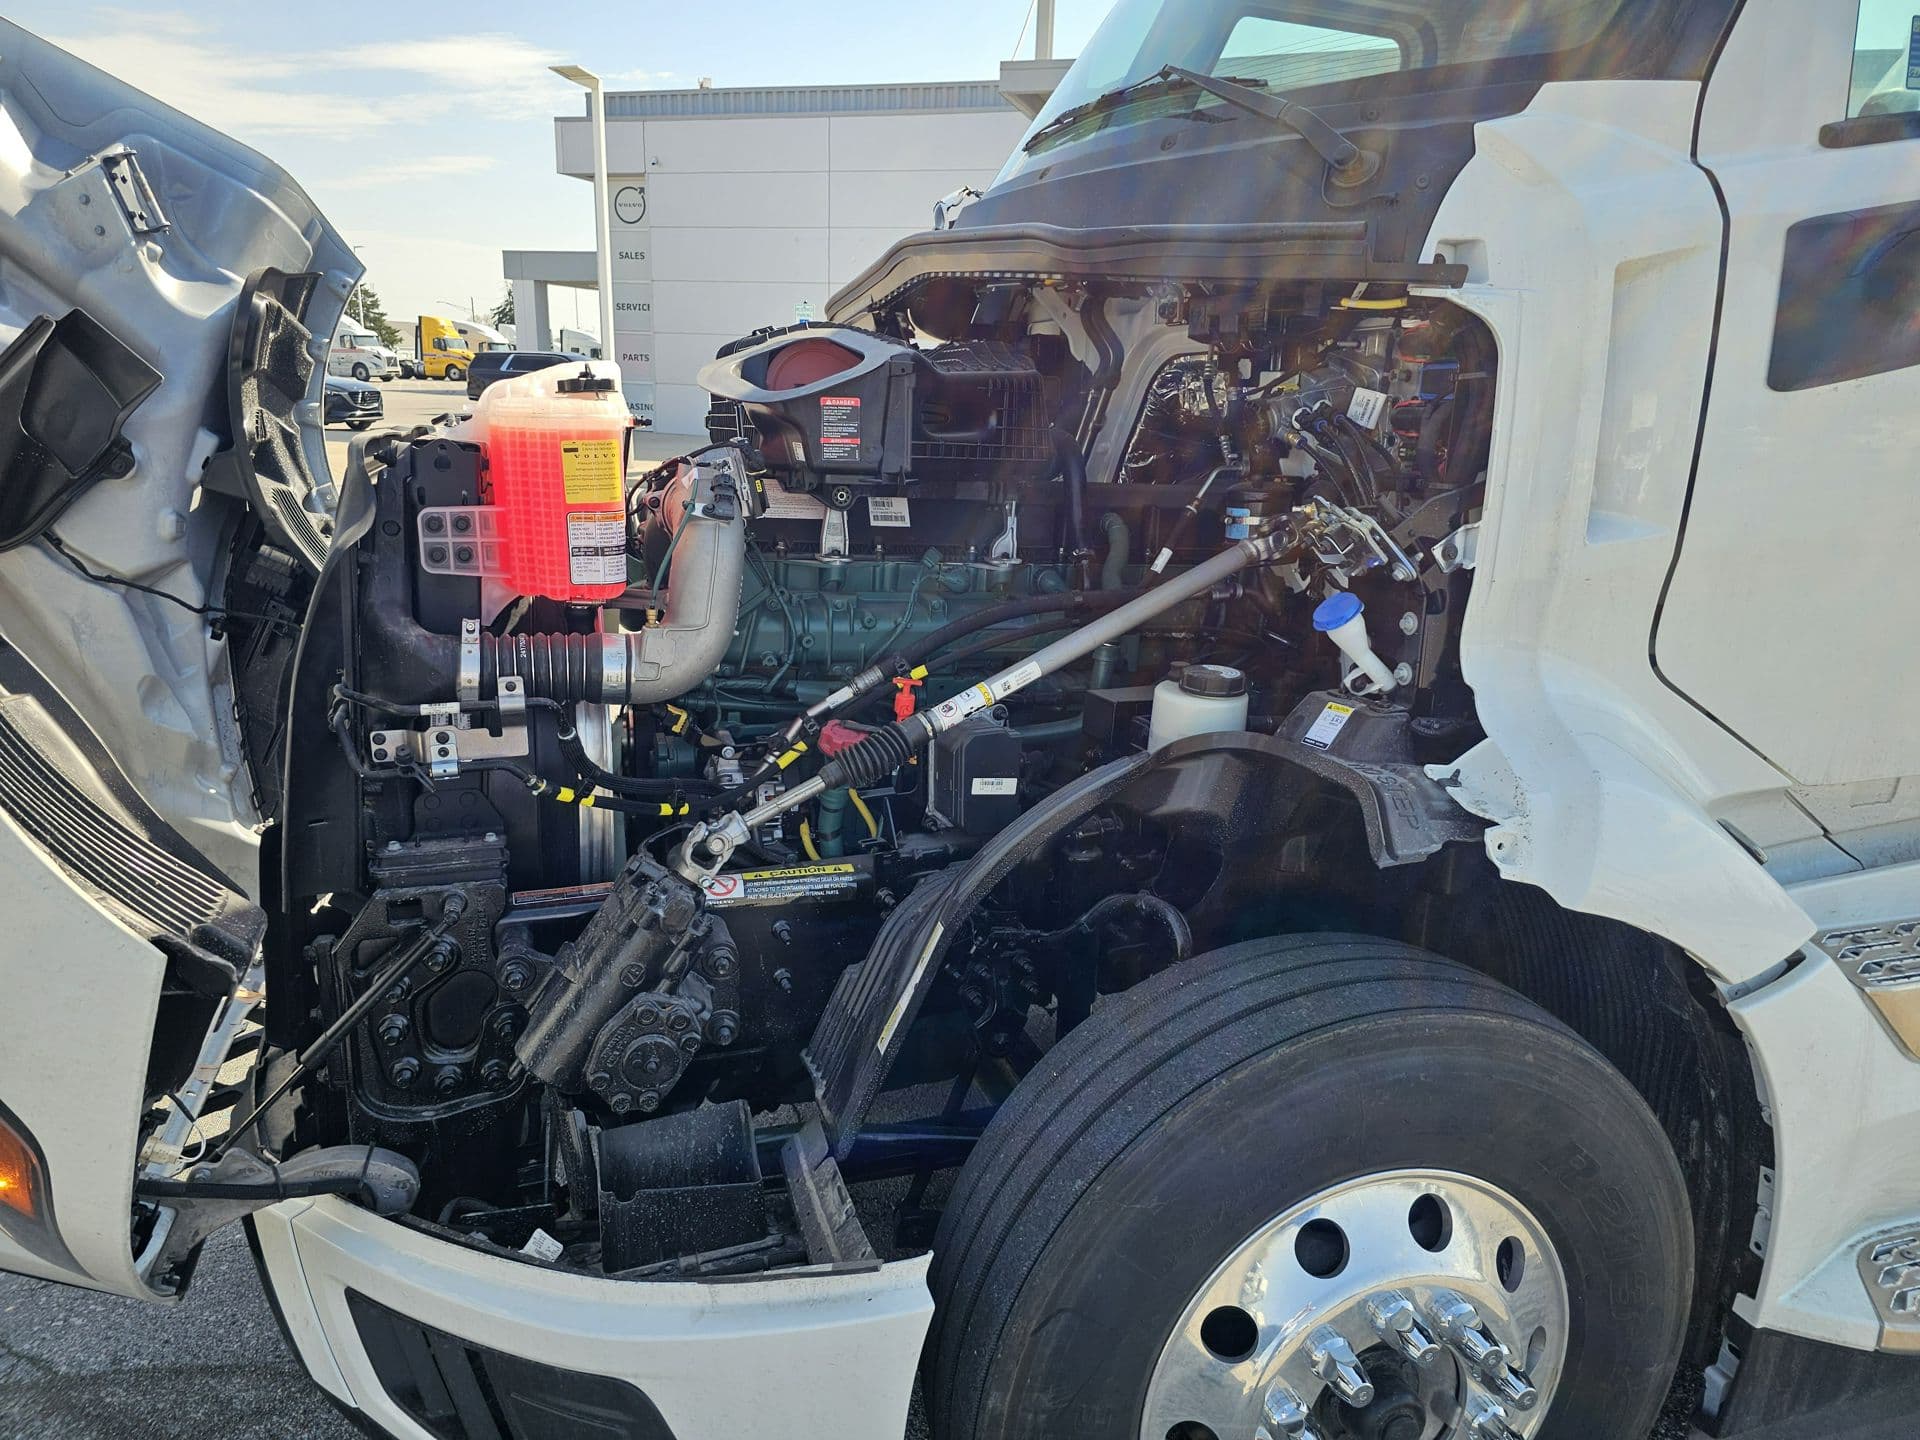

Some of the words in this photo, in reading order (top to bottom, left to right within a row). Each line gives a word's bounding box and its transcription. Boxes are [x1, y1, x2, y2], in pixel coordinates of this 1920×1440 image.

[619, 251, 645, 260] SALES
[623, 353, 650, 361] PARTS
[769, 866, 826, 877] CAUTION
